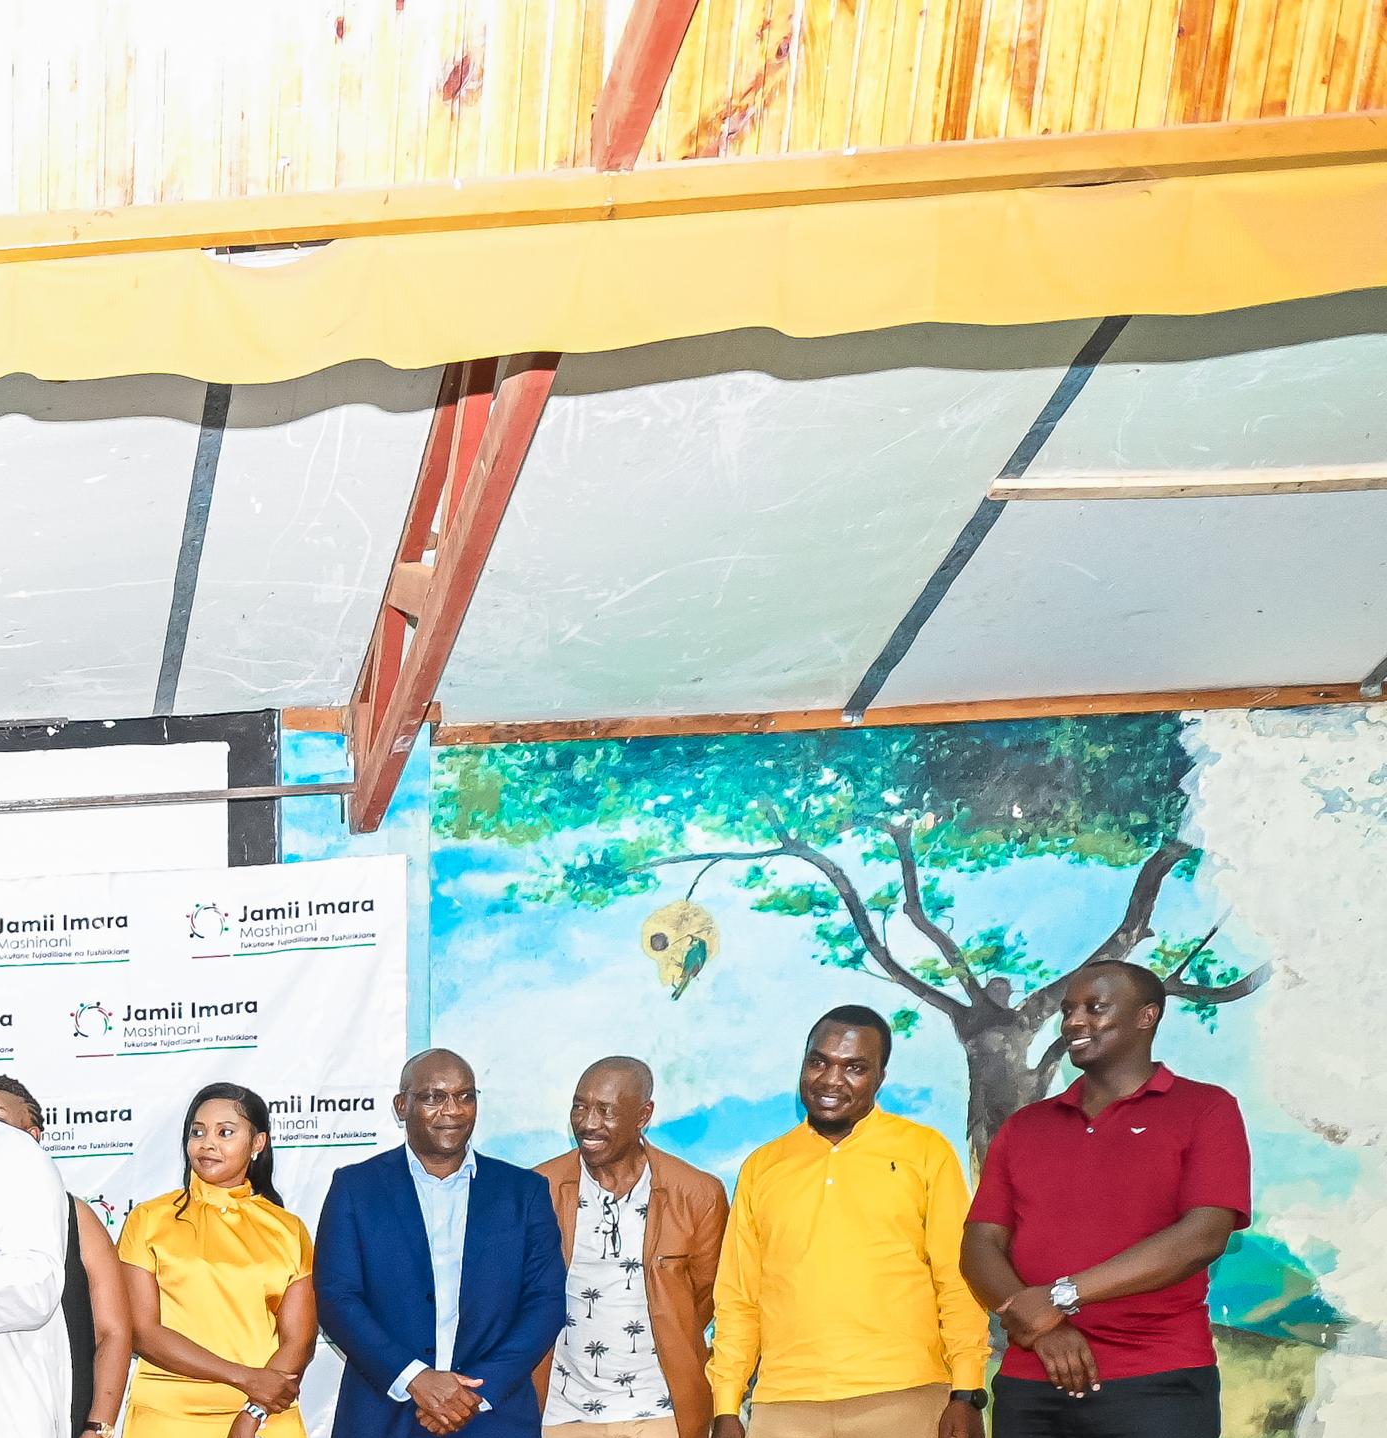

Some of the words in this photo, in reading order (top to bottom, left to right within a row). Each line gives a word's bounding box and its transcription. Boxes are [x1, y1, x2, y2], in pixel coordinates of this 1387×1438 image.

[238, 901, 299, 922] Jamii
[308, 899, 374, 916] Imara
[63, 914, 128, 931] Imara
[240, 919, 317, 938] Mashinani
[122, 1002, 182, 1022] Jamii
[191, 1001, 258, 1018] Imara
[123, 1022, 200, 1038] Mashinani
[268, 1095, 302, 1113] mii
[310, 1095, 375, 1112] Imara
[66, 1108, 132, 1124] Imara
[272, 1116, 318, 1130] hinani
